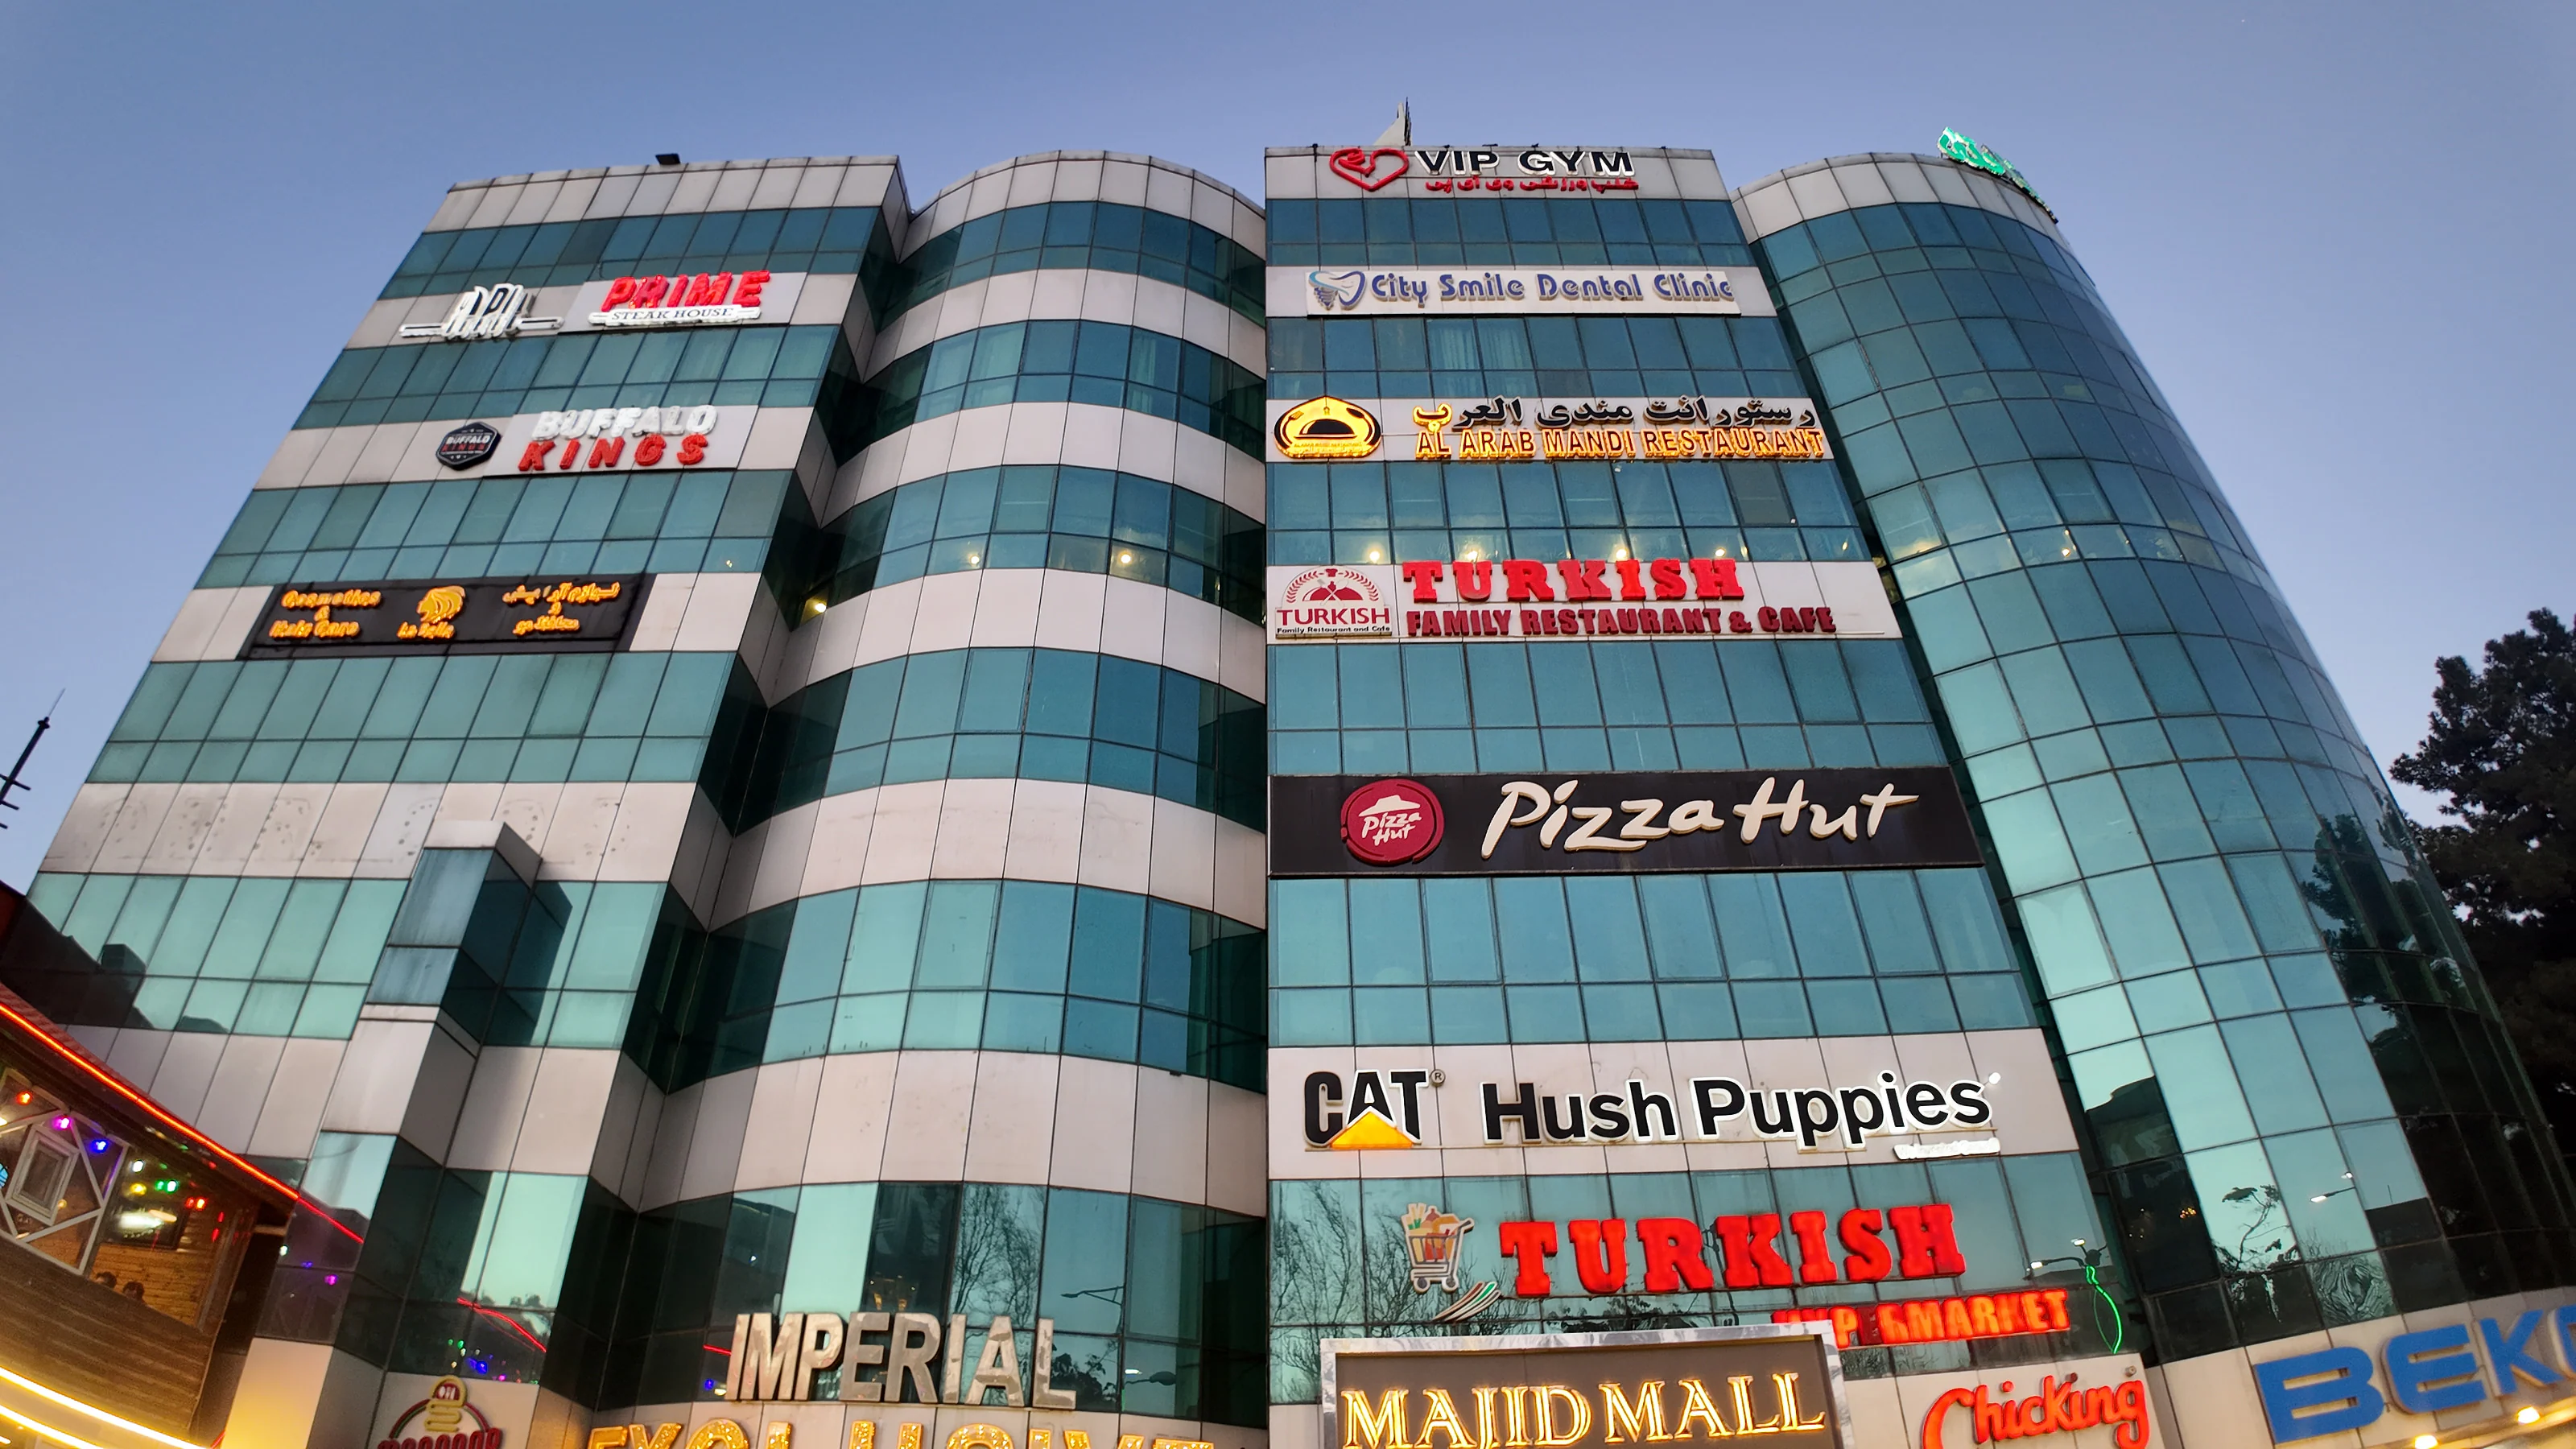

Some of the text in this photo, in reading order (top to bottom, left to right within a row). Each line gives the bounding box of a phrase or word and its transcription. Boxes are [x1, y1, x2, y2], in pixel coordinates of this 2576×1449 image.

[1414, 150, 1637, 176] VIP GYM
[601, 270, 770, 312] PRIME
[1370, 272, 1735, 308] City Smile Dental Clinic
[612, 307, 734, 321] STEAK HOUSE
[445, 435, 491, 444] BUFFALO
[531, 404, 718, 440] BUFFALO
[518, 433, 708, 471] KINGS
[1415, 427, 1825, 459] AL ARAB MANDI RESTAURANT
[1402, 558, 1745, 603] TURKISH
[1276, 608, 1390, 625] TURKISH
[1277, 626, 1305, 634] Family
[1406, 605, 1837, 637] FAMILY RESTAURANT & CAFE
[1361, 811, 1422, 839] Pizza
[1373, 824, 1416, 846] Hut
[1480, 777, 1920, 861] Pizza Hut
[1304, 1069, 1429, 1147] CAT
[1480, 1069, 1993, 1154] Hush Puppies
[1499, 1204, 1967, 1298] TURKISH
[724, 1311, 1076, 1410] IMPERIAL
[1340, 1373, 1827, 1449] MAJID MALL
